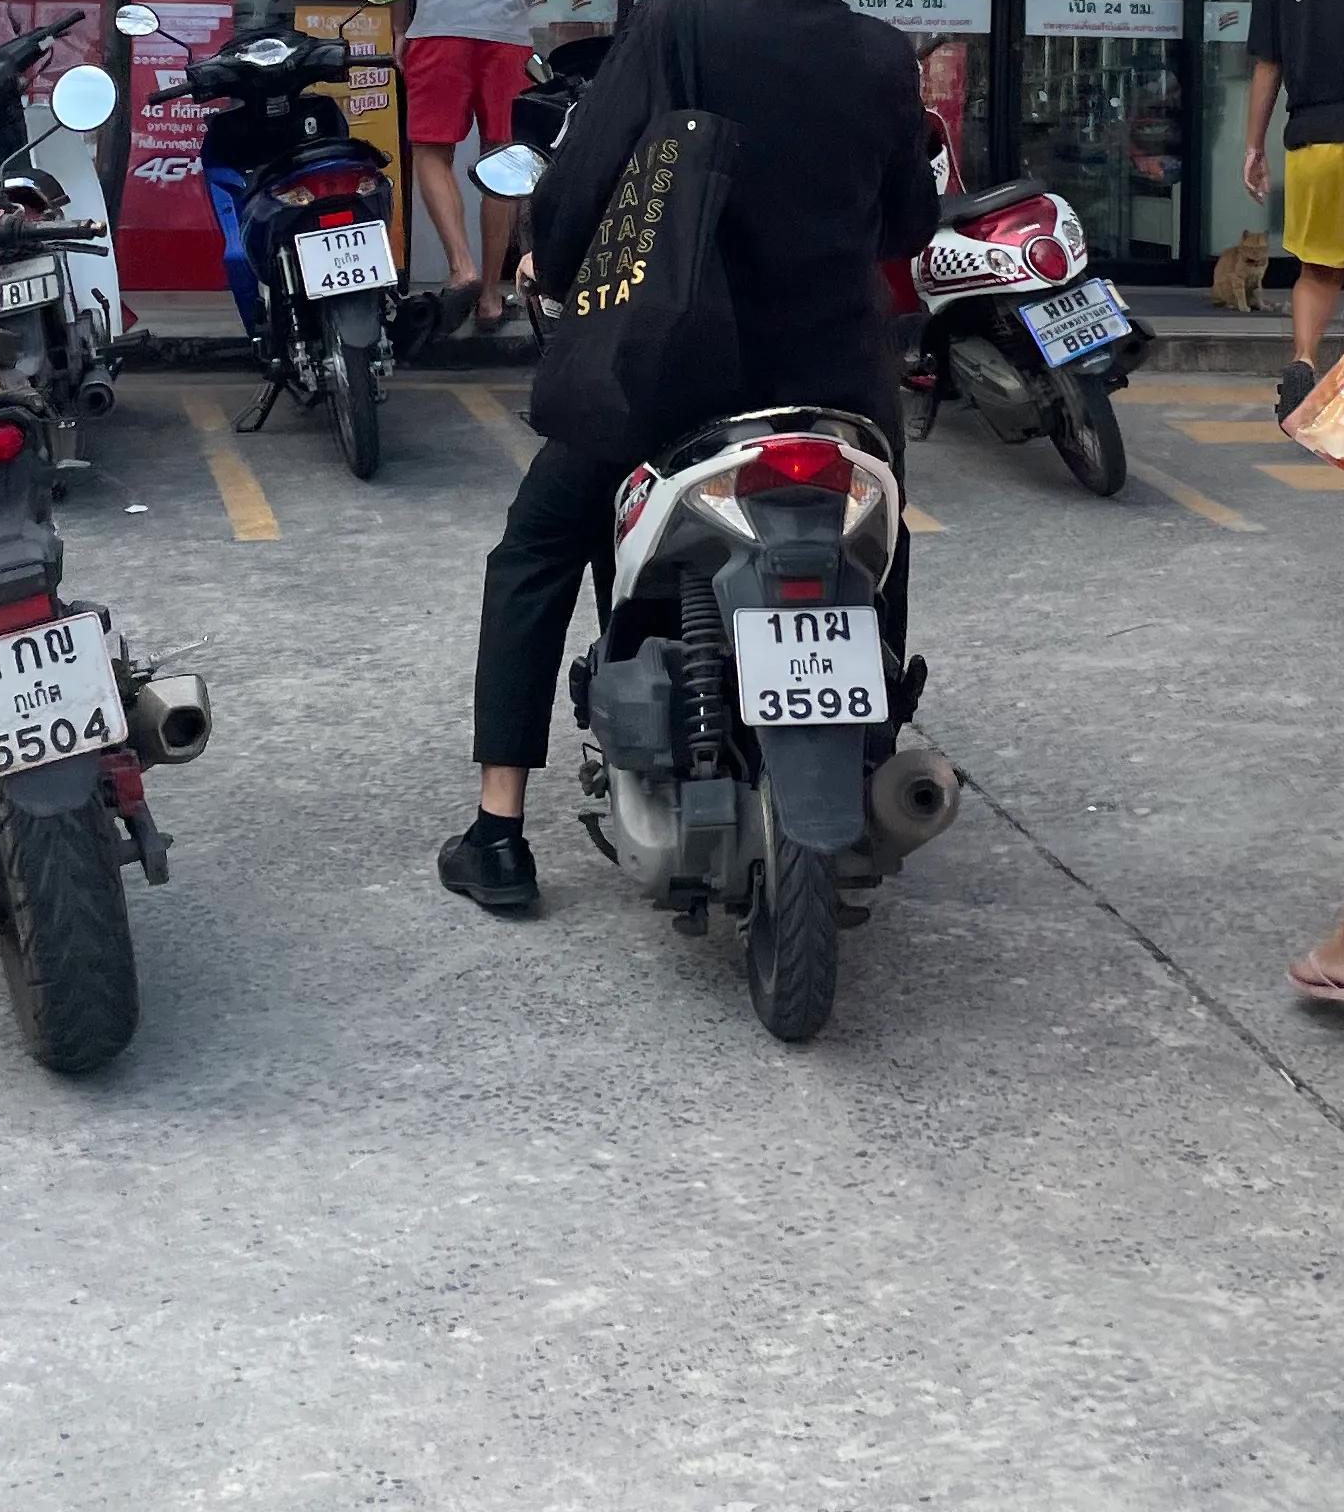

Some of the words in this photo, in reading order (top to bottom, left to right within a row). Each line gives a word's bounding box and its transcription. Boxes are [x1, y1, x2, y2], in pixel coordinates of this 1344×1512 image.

[1104, 2, 1122, 15] 24
[141, 104, 164, 118] 4G
[321, 265, 379, 289] 4381
[790, 651, 834, 682] ภูเก็ต
[13, 680, 62, 719] ภูเก็ต
[758, 686, 873, 721] 3598
